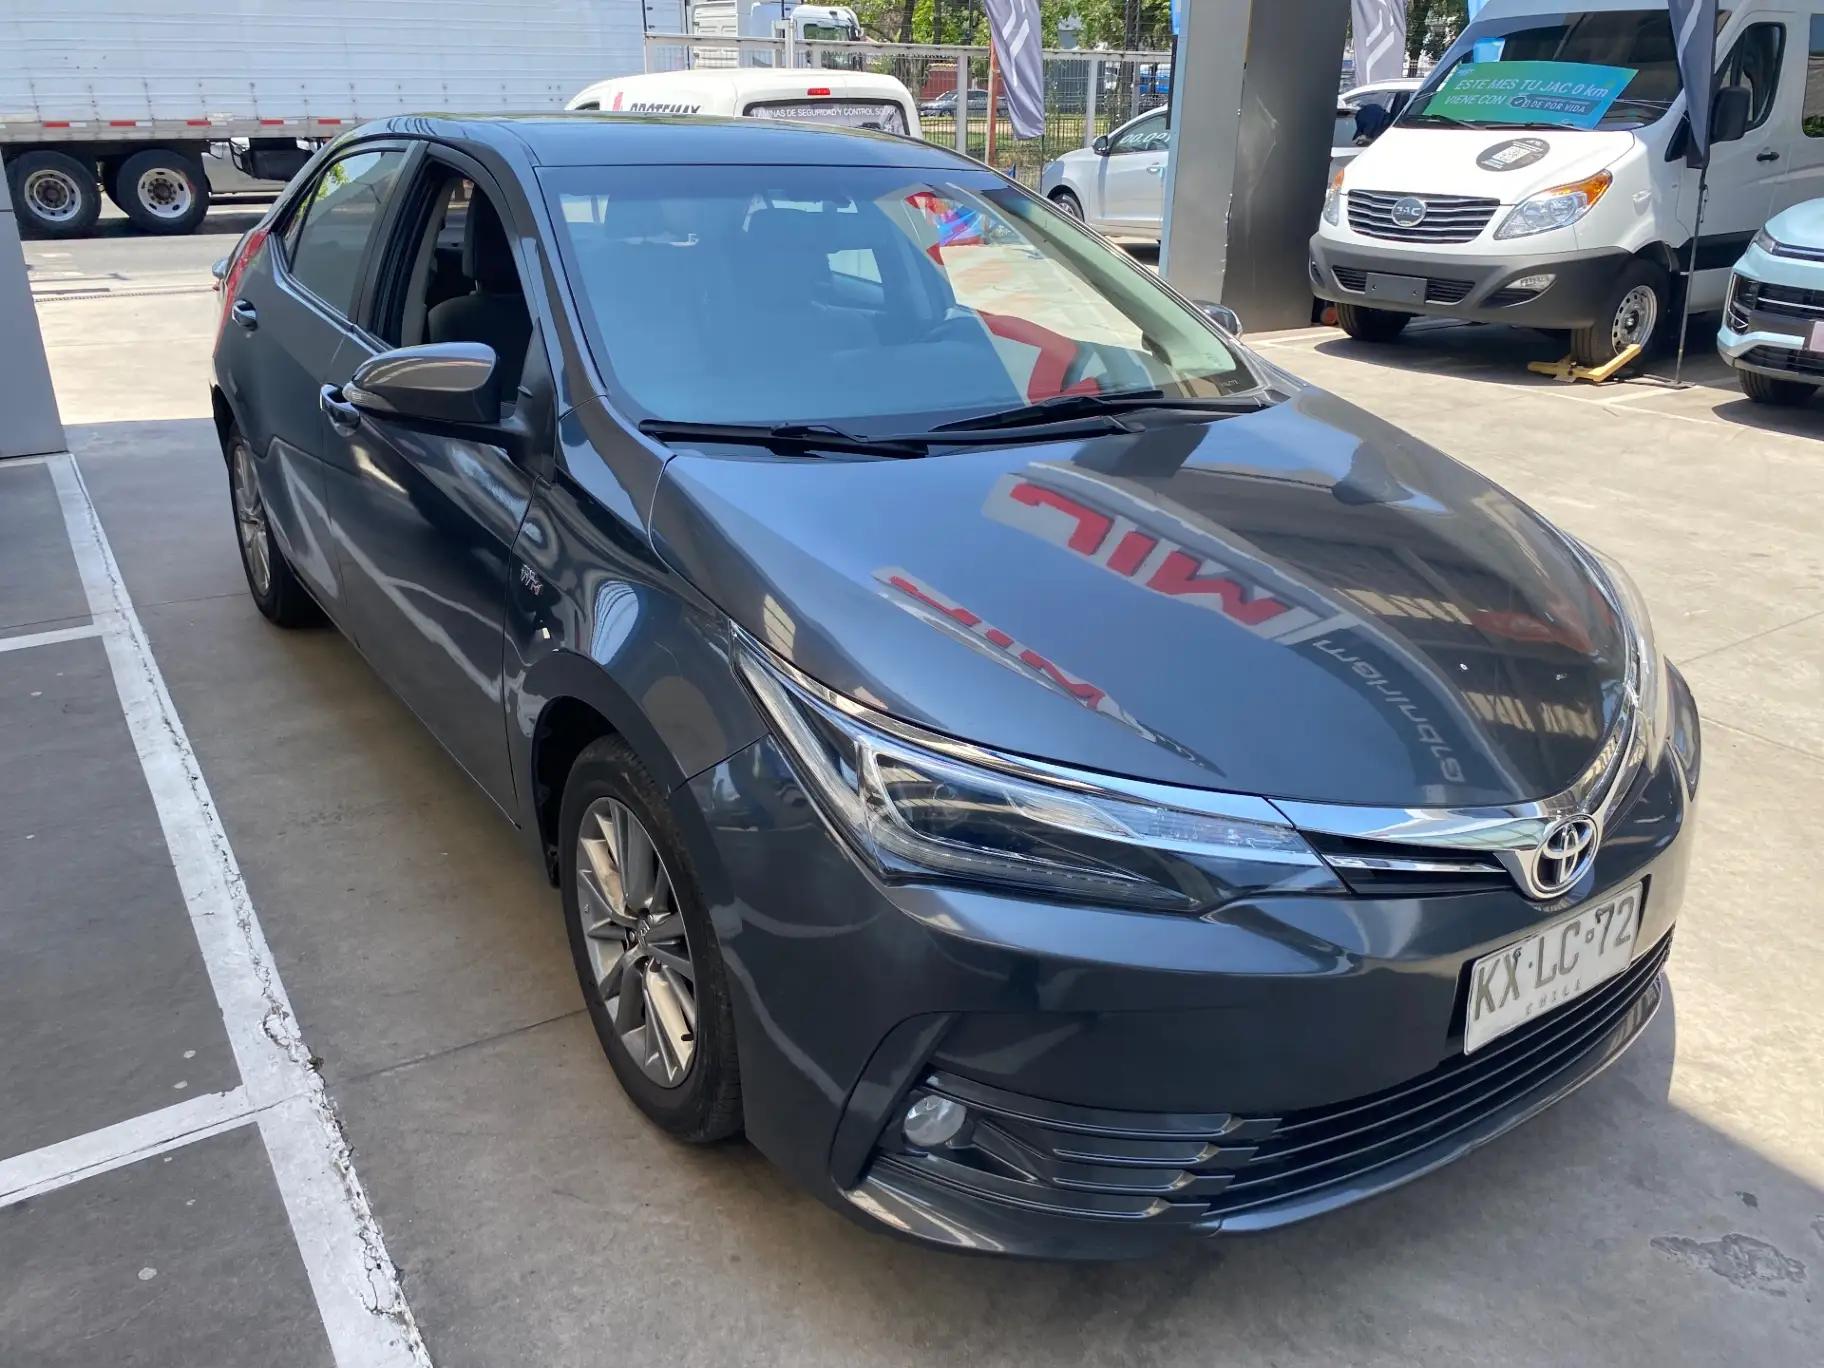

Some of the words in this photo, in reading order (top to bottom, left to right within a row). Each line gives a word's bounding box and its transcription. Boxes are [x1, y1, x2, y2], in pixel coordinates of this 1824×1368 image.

[1454, 79, 1489, 91] ESTE
[1488, 79, 1520, 91] MES
[1520, 79, 1541, 91] TU
[1540, 81, 1573, 94] JAC
[1584, 84, 1609, 98] km
[1444, 94, 1480, 105] VIENE
[1478, 94, 1507, 105] CON
[786, 109, 797, 117] DE
[797, 107, 837, 117] SEGURIDAD
[843, 107, 875, 116] CONTROL
